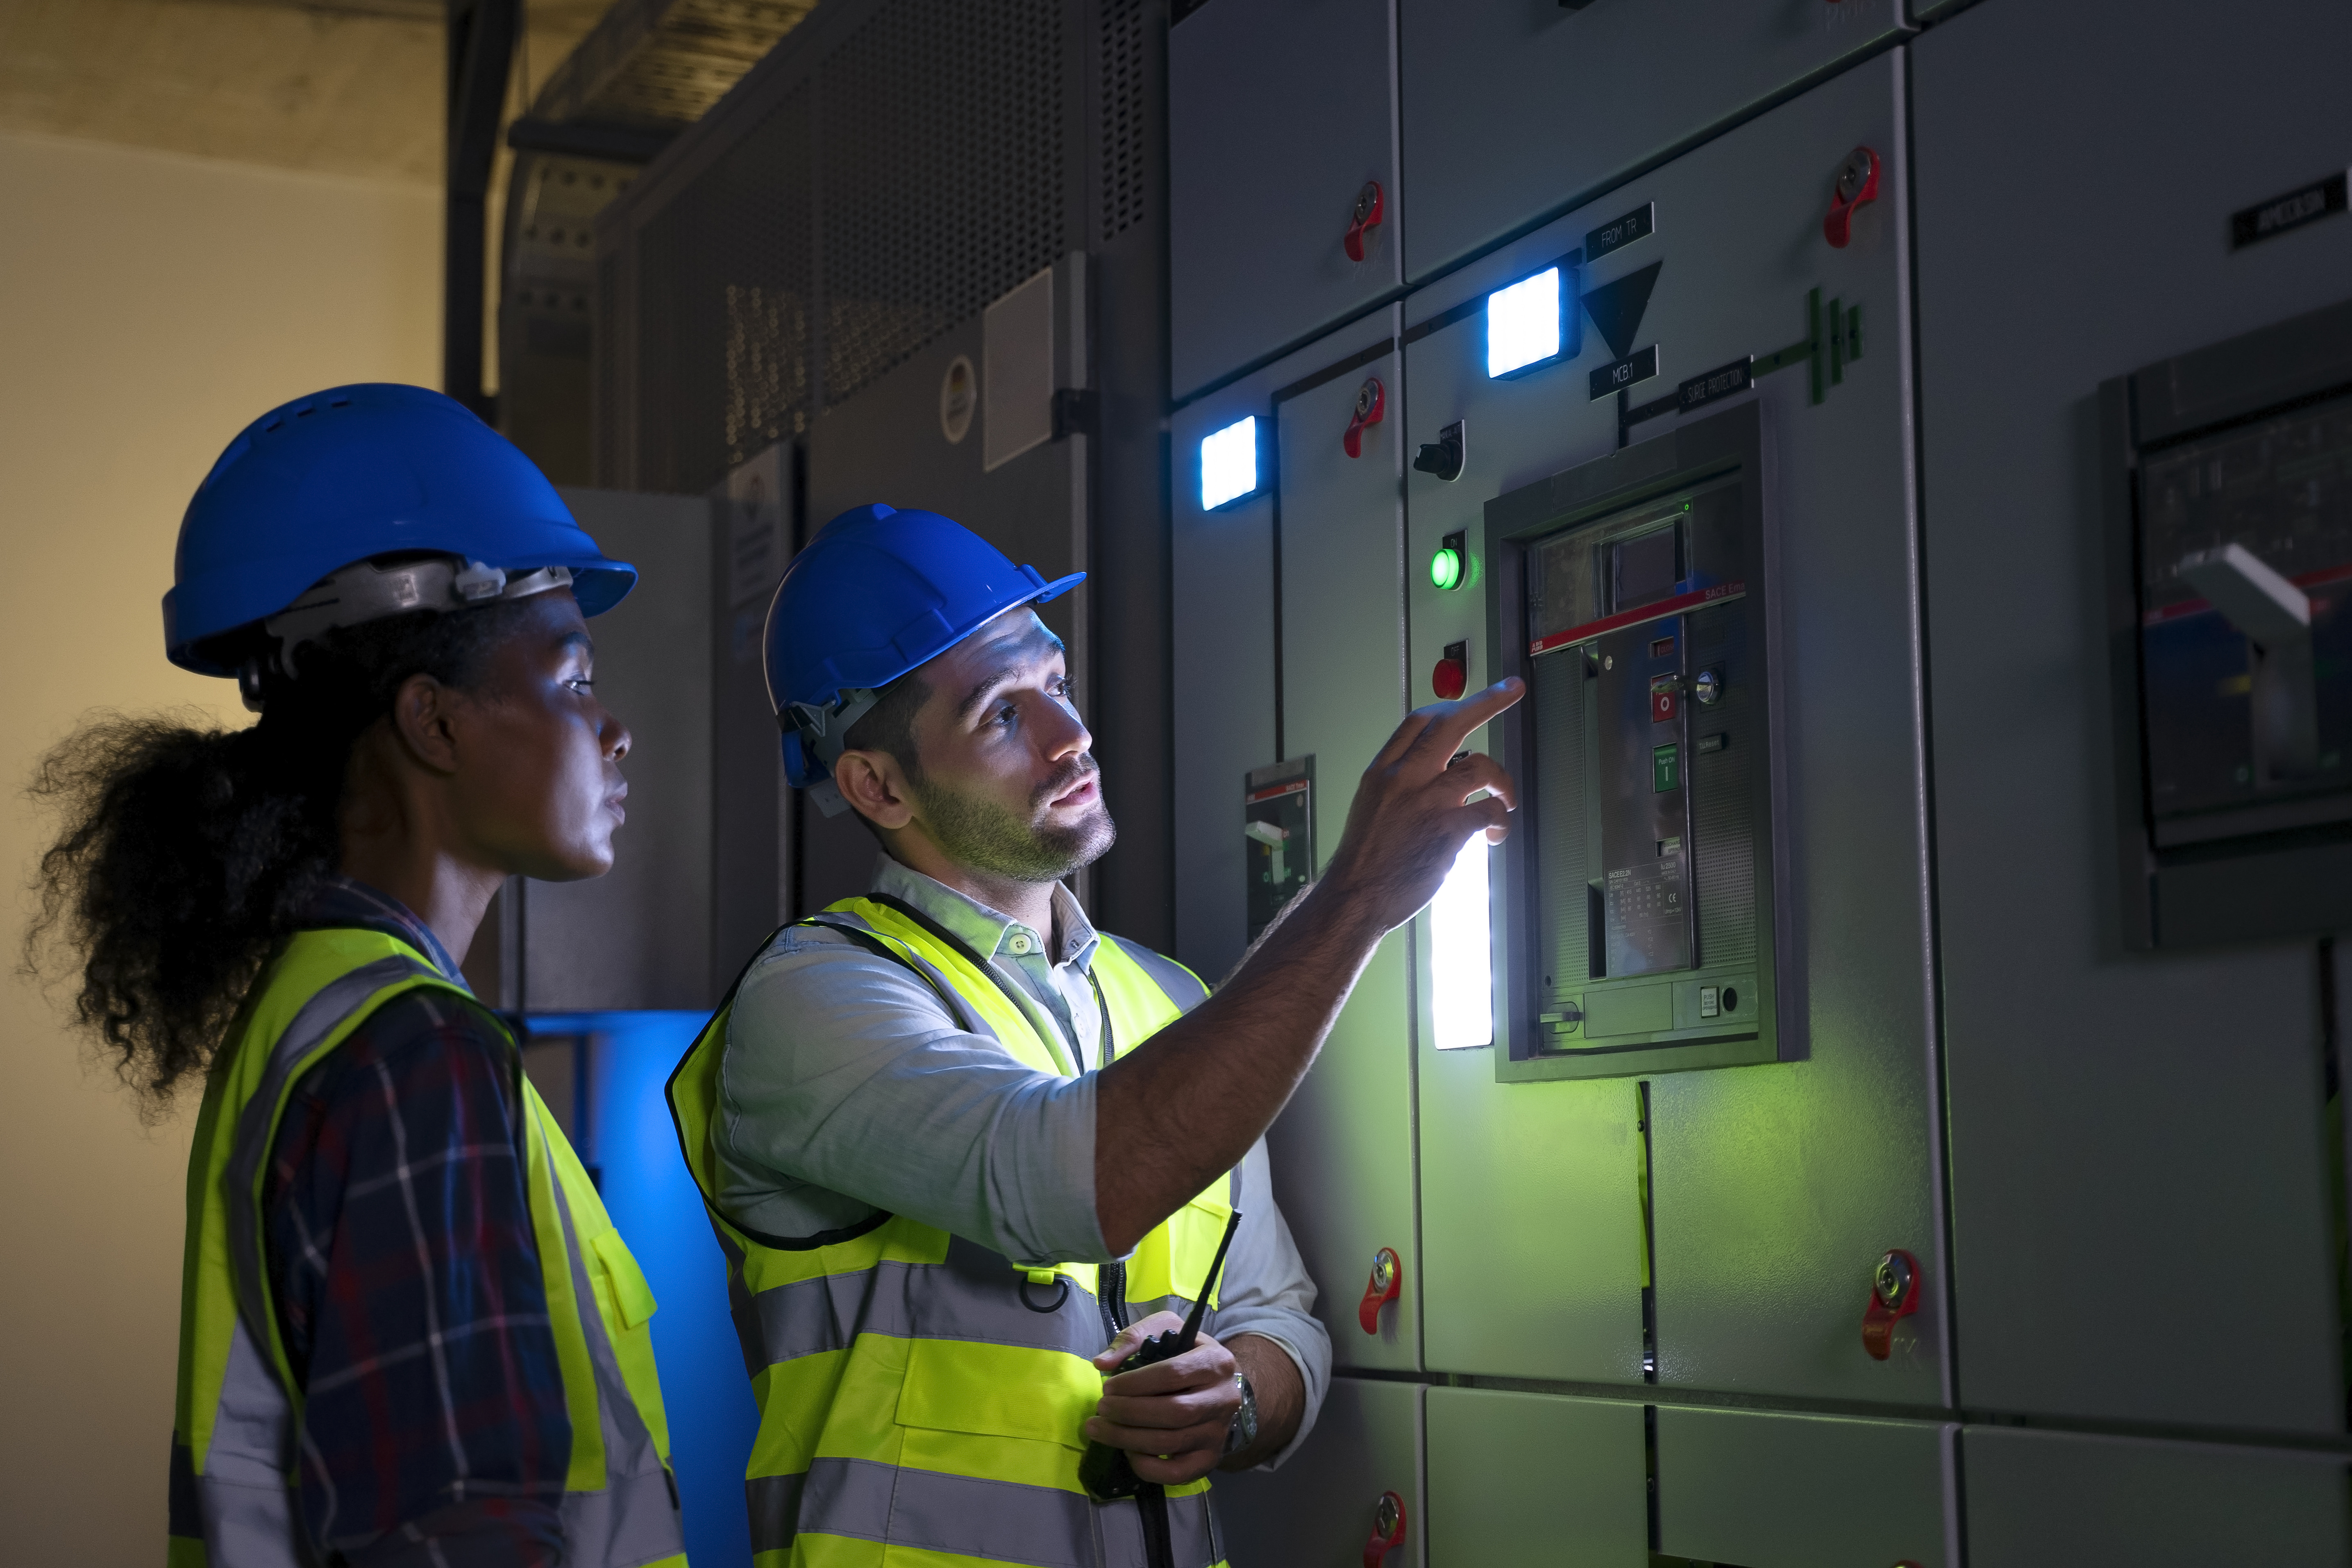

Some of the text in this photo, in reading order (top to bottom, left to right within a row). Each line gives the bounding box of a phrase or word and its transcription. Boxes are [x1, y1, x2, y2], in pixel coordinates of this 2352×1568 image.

[1602, 218, 1637, 248] FROM TR
[1613, 362, 1633, 384] MCB.1
[1688, 367, 1743, 403] SURGE PROTECTION
[1451, 538, 1457, 548] ON
[1705, 585, 1726, 599] SACE
[1451, 645, 1460, 656] OFF
[1532, 640, 1543, 653] ABB
